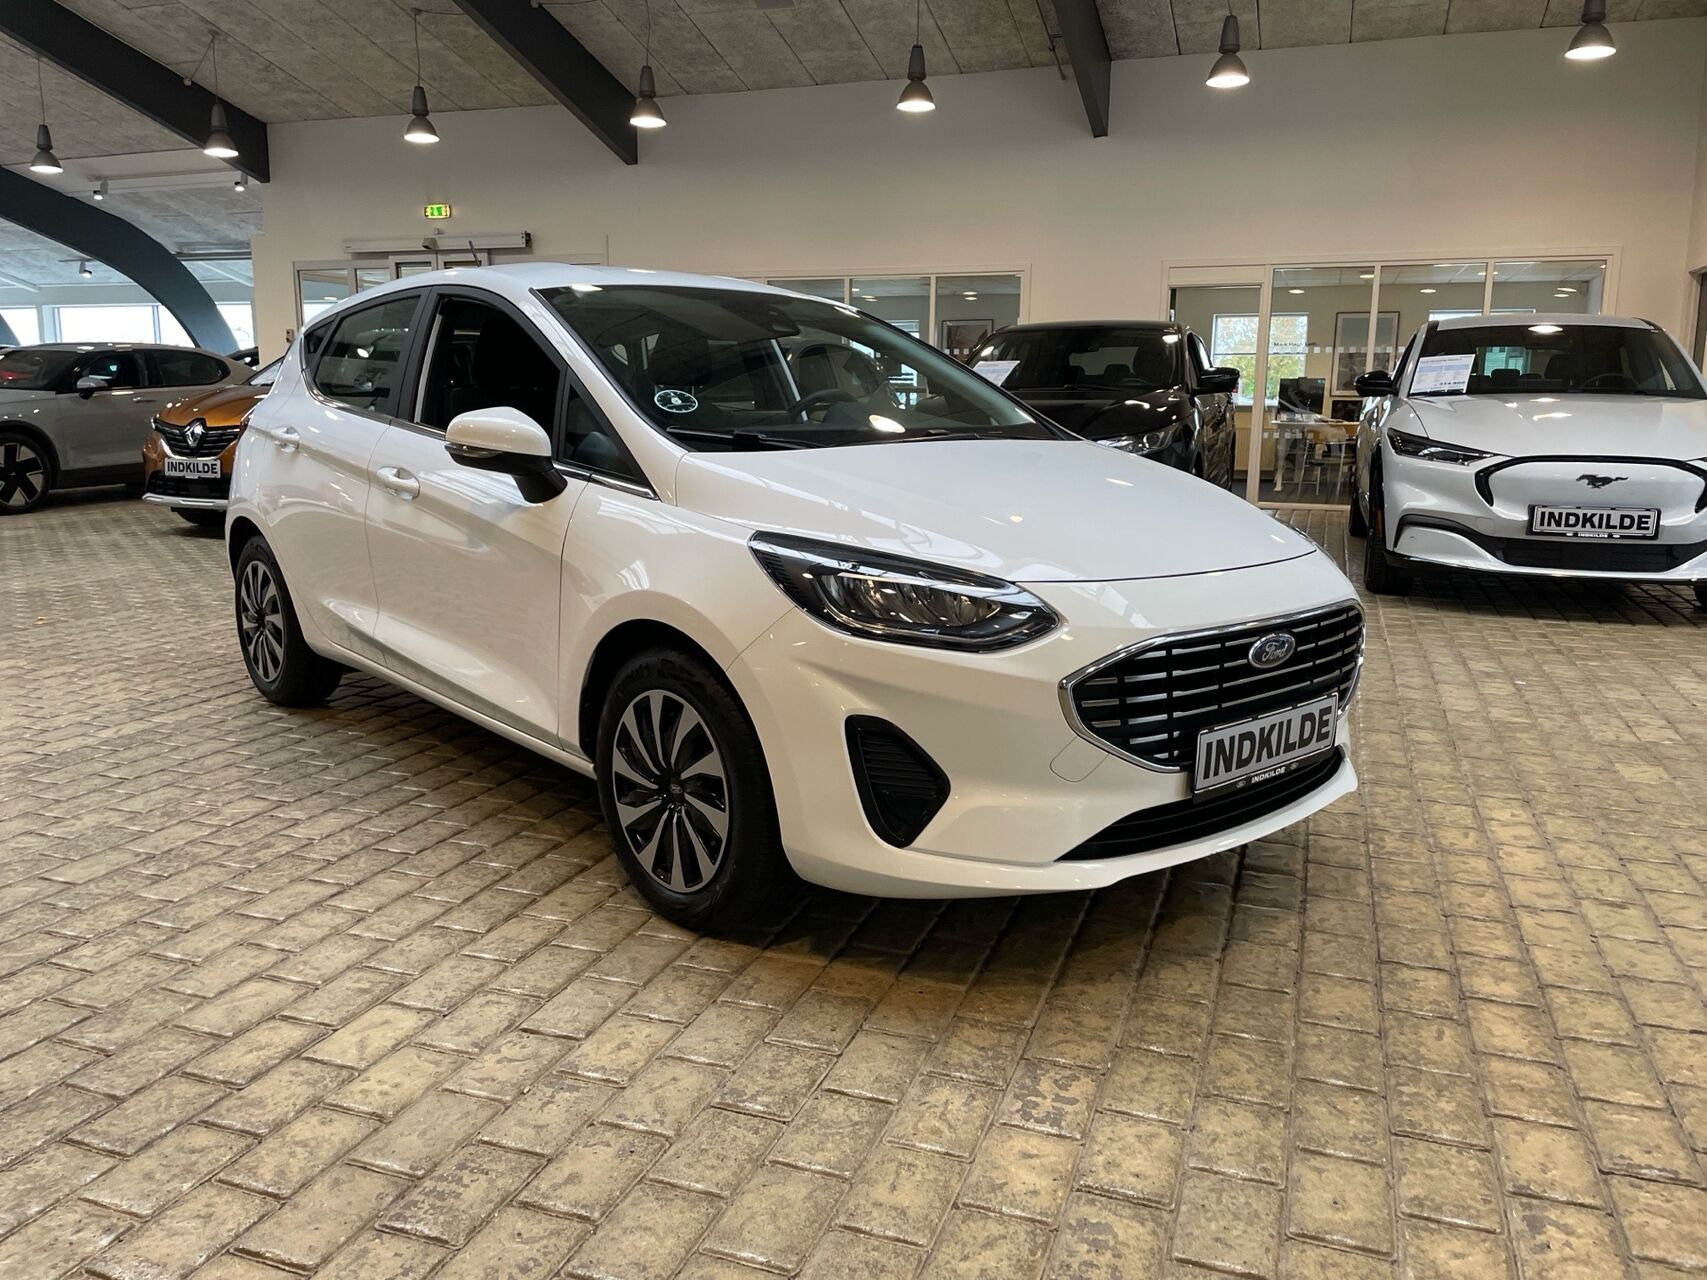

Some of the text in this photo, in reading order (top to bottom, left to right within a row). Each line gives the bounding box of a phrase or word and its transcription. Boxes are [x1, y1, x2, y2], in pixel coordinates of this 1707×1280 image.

[168, 461, 217, 474] INDKILDE
[1539, 511, 1651, 530] INDKILDE
[1262, 643, 1288, 662] Ford
[1203, 706, 1333, 780] INDKILDE
[1251, 767, 1286, 784] INDKILDE
